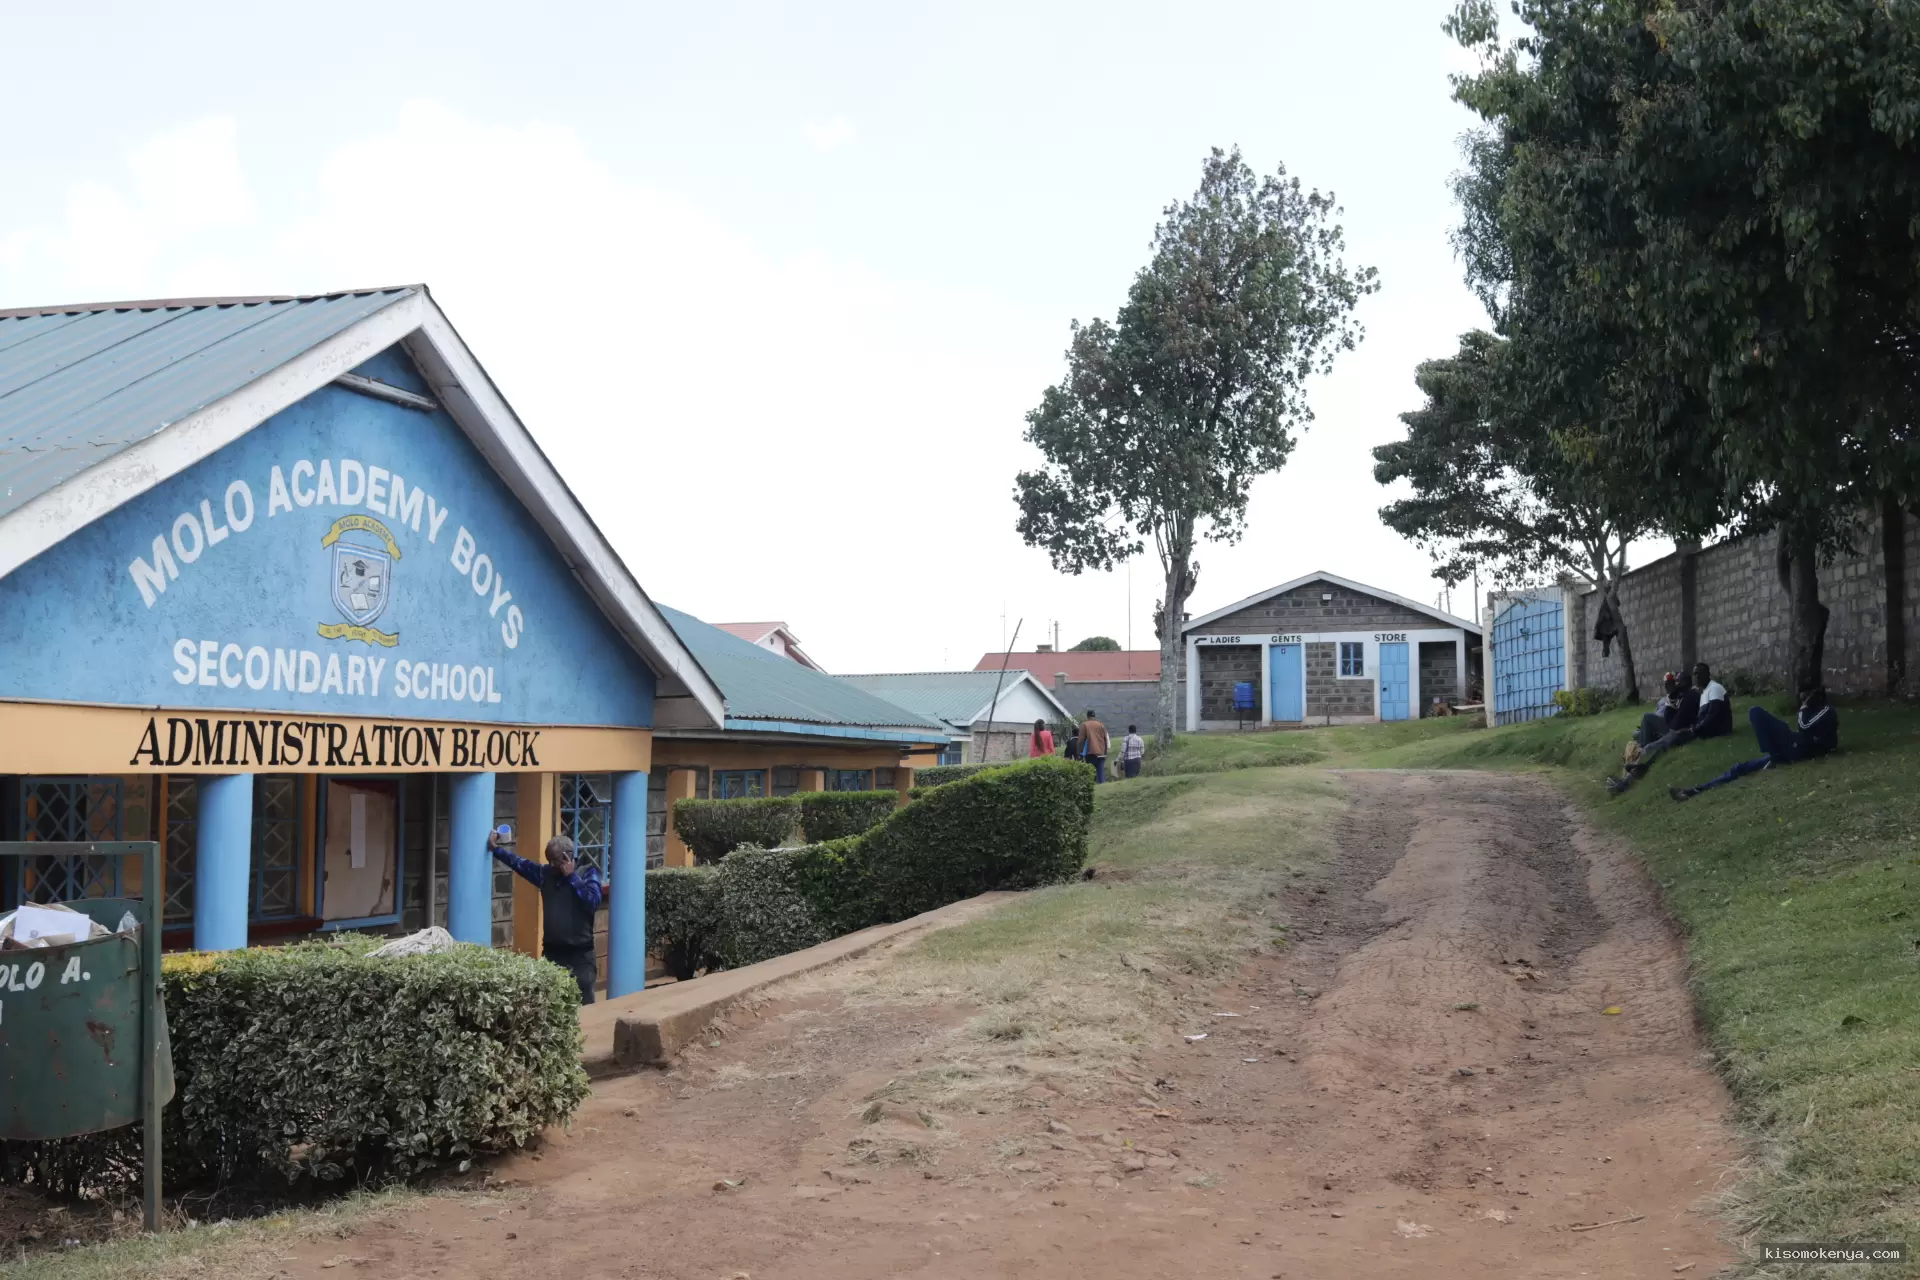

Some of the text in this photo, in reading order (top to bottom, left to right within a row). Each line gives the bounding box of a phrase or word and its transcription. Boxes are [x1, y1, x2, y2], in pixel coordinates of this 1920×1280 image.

[128, 459, 524, 649] MOLO ACADEMY BOYS
[1210, 633, 1407, 644] LADIES GENTS STORE
[173, 638, 502, 703] SECONDARY SCHOOL
[130, 717, 540, 767] ADMINISTRATION BLOCK
[60, 956, 91, 985] A.
